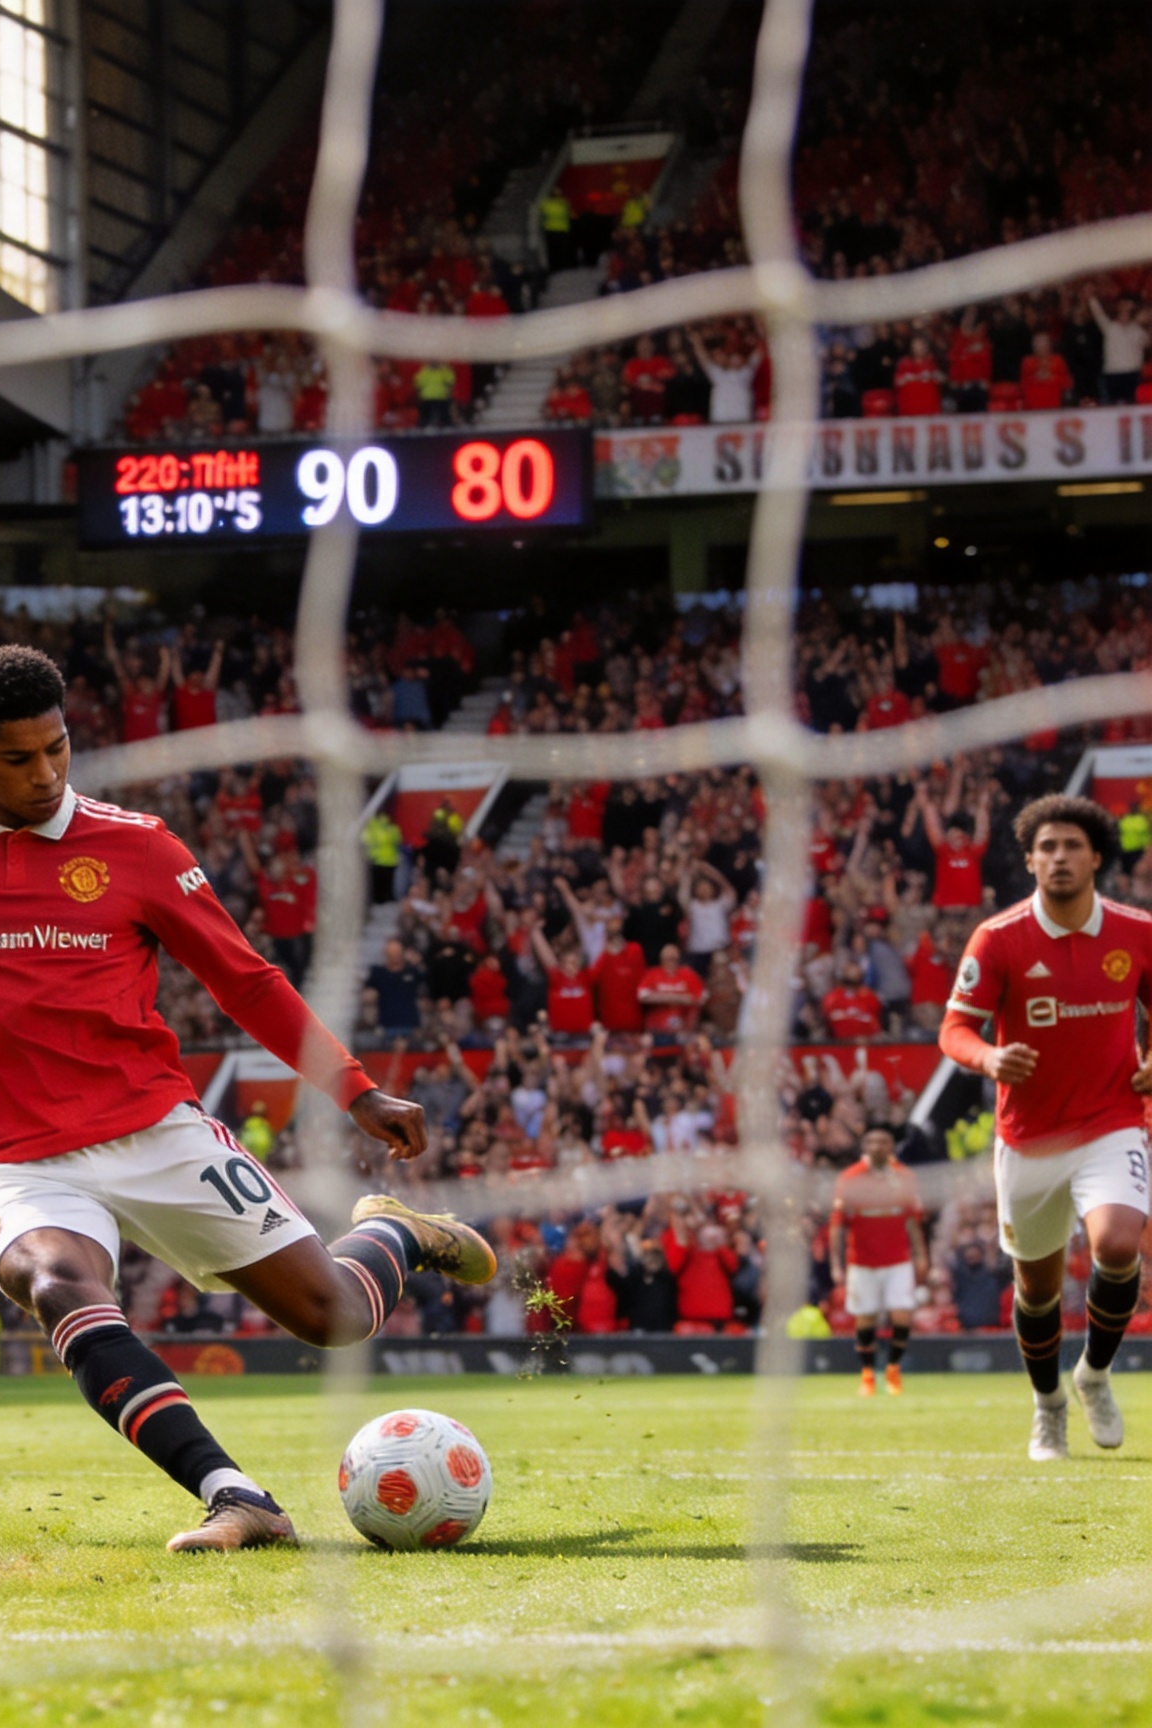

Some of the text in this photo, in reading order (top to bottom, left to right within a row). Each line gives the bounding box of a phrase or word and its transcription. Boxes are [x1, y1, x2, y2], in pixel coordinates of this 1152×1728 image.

[297, 439, 554, 526] 90 80
[200, 1157, 272, 1215] 10
